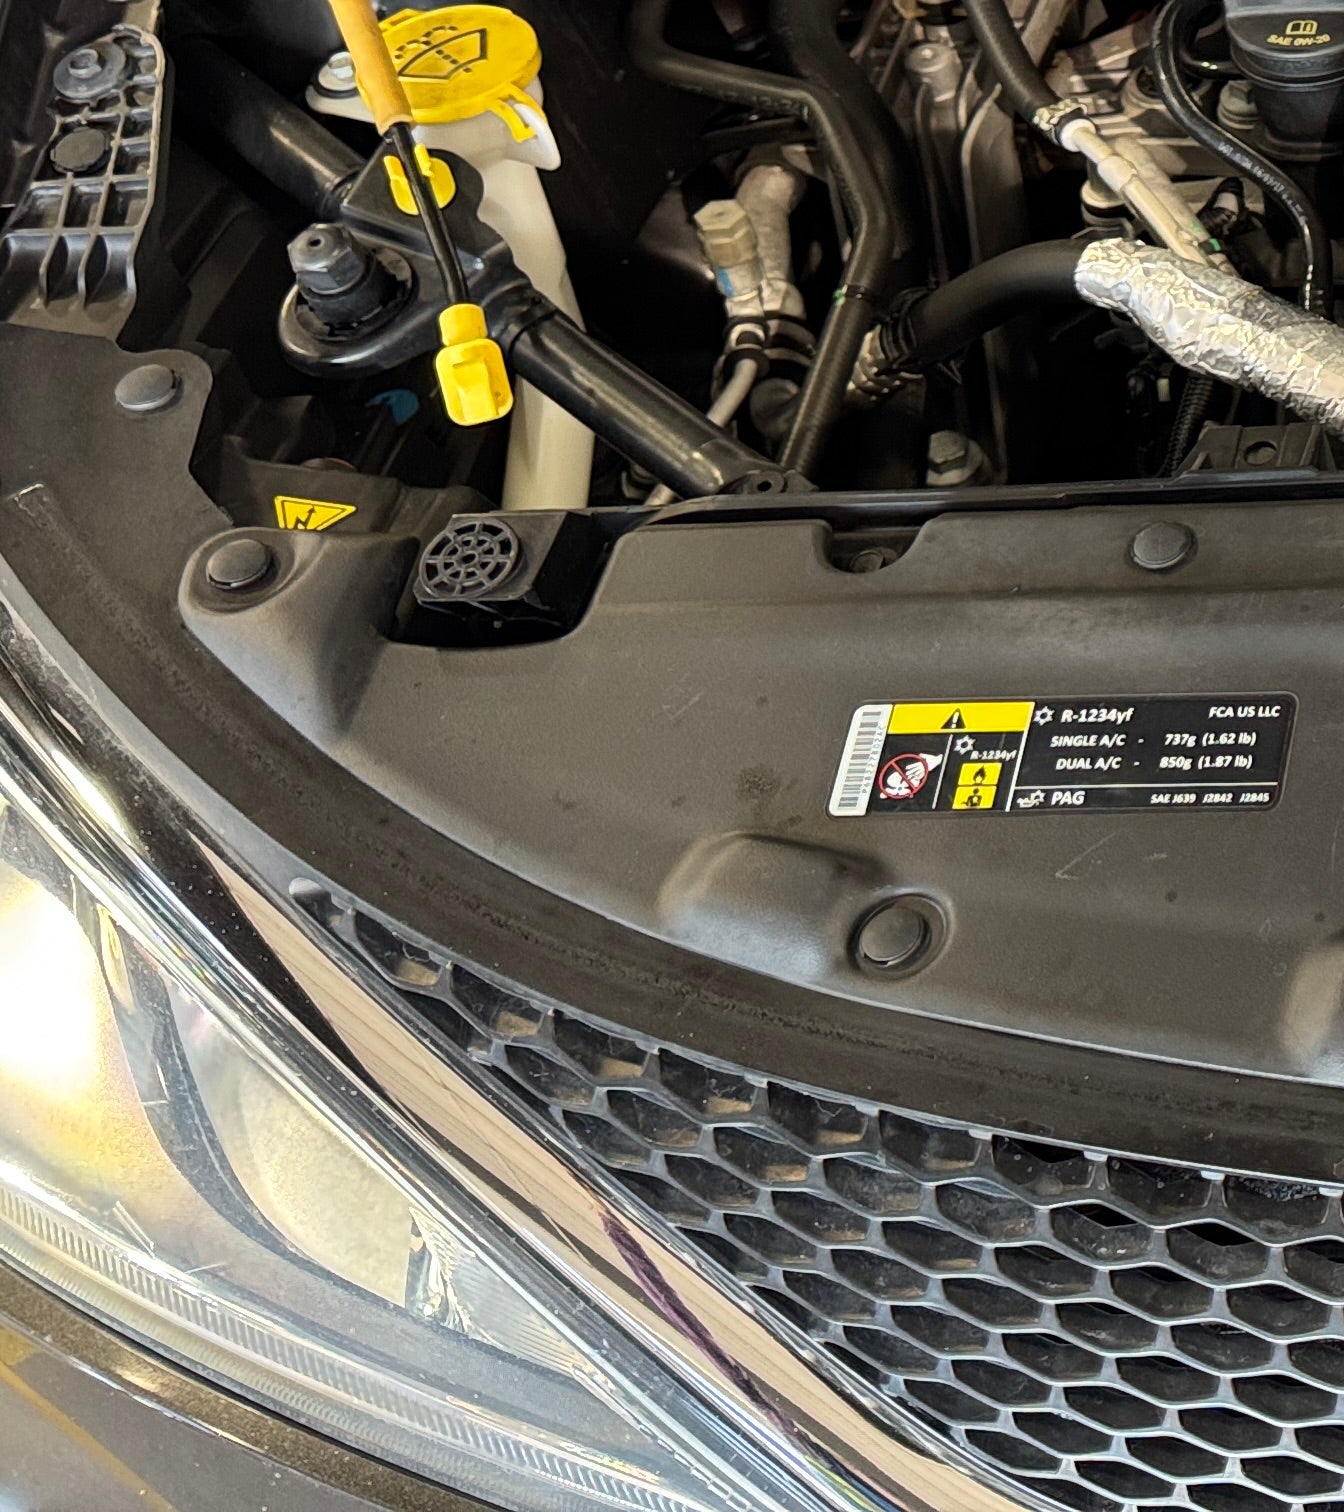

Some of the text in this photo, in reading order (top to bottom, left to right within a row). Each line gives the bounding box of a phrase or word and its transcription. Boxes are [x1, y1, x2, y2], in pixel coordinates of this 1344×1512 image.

[1266, 33, 1332, 47] SAE 0W-20
[1060, 706, 1135, 726] R-1234yf
[1208, 705, 1281, 719] FCA US LLC
[1050, 735, 1099, 748] SINGLE
[1099, 733, 1127, 748] A/C
[1164, 733, 1198, 748] 737g
[1201, 732, 1236, 747] (1.62
[1238, 731, 1257, 747] lb)
[1055, 757, 1093, 770] DUAL
[1094, 756, 1122, 770] A/C
[1159, 755, 1193, 771] 850g
[1197, 754, 1232, 770] (1.87
[1234, 753, 1253, 768] lb)
[1050, 790, 1086, 806] PAG
[1150, 792, 1270, 804] SAE J639 J2842 J2845
